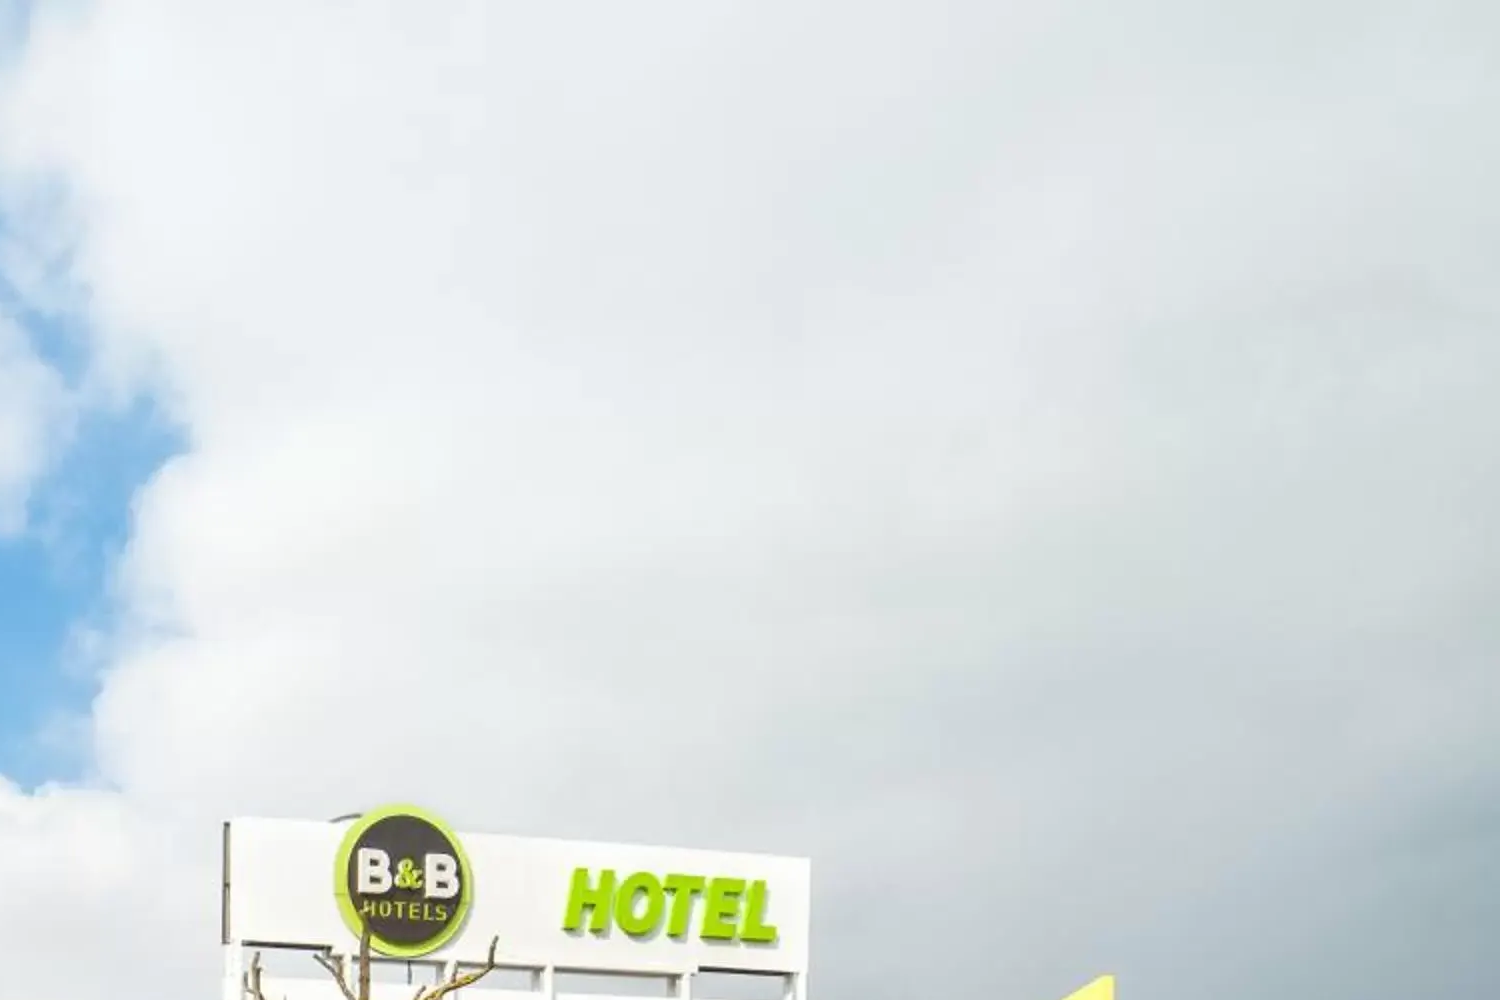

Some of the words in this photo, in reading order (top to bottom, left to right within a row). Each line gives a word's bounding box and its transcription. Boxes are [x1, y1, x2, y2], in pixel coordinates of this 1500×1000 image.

[357, 847, 460, 899] B&B
[361, 900, 448, 921] HOTELS
[562, 867, 778, 943] HOTEL
